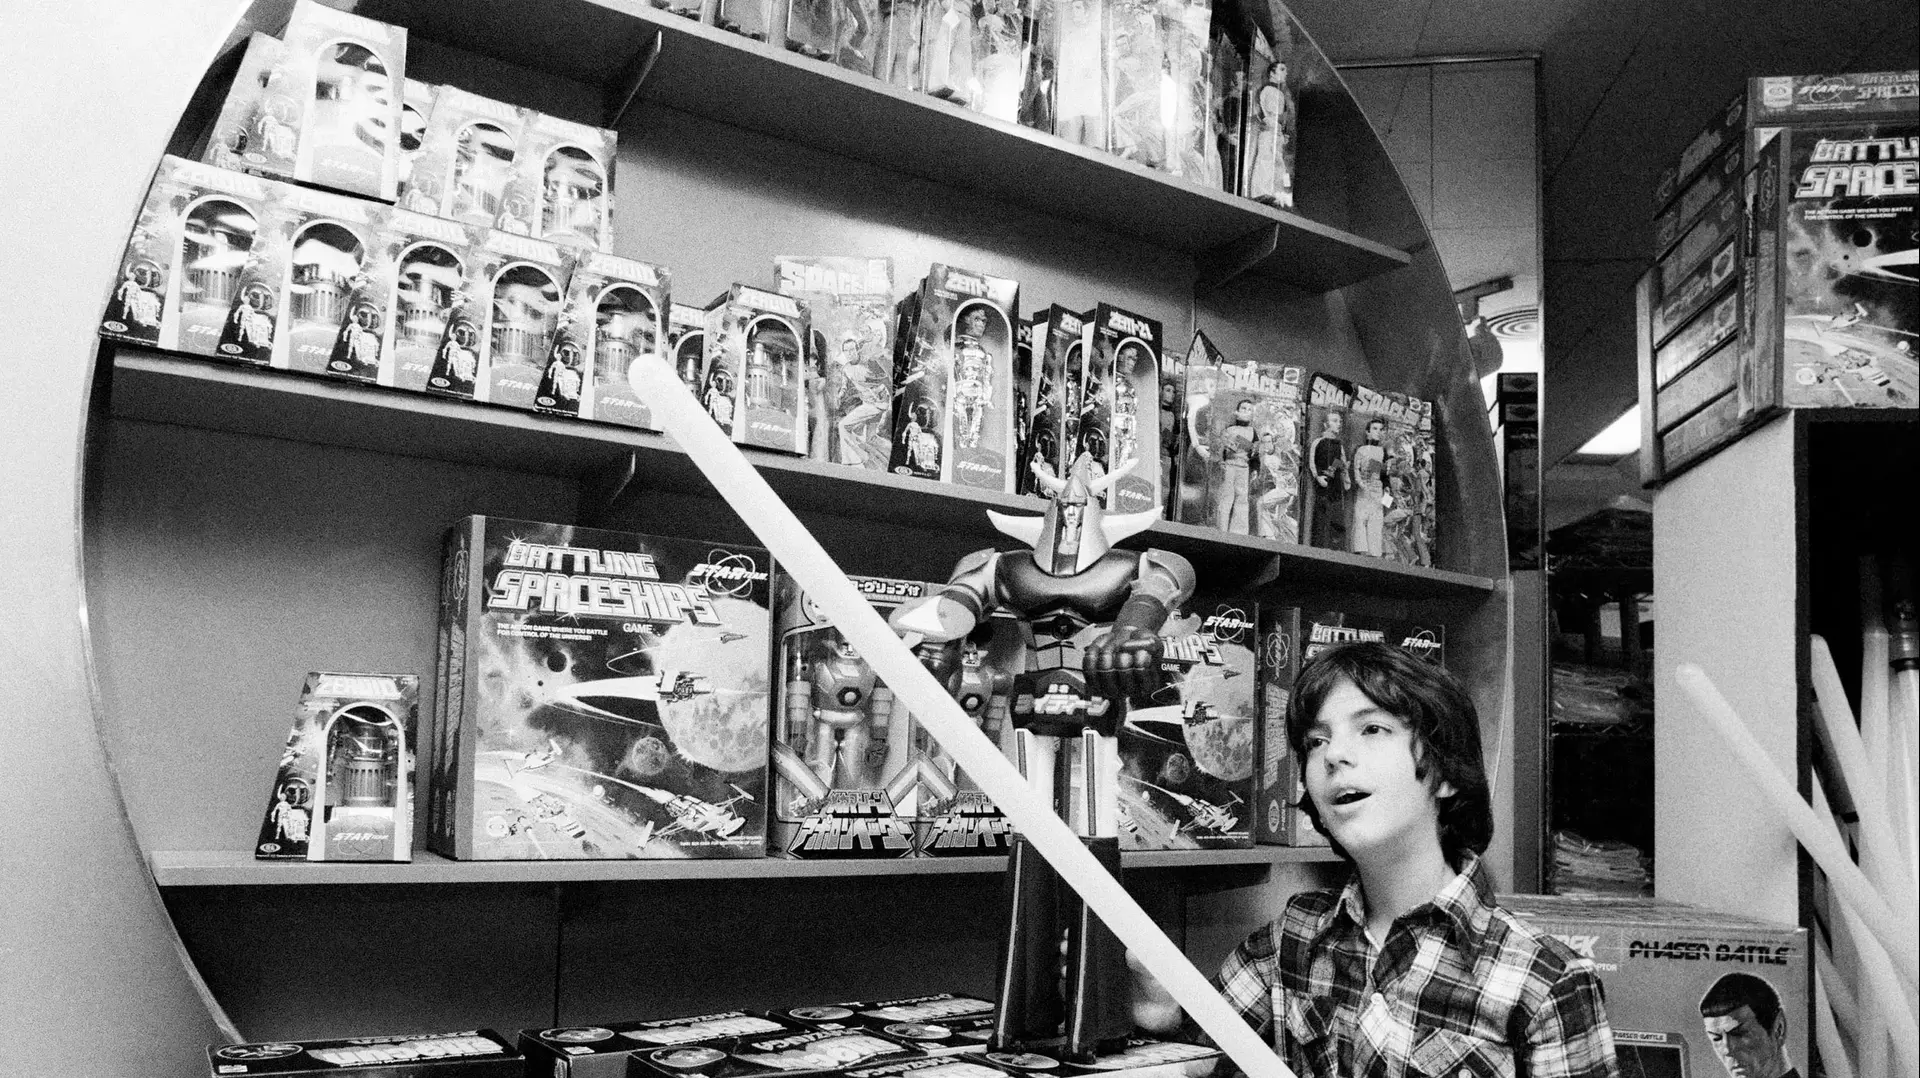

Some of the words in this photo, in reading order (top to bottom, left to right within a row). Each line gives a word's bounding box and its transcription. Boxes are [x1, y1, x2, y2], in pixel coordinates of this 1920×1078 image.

[1794, 161, 1919, 199] SPACE
[503, 542, 660, 580] BATTLING
[688, 563, 745, 580] STAR
[487, 569, 722, 628] SPACESHIPS
[497, 622, 510, 630] THE
[511, 623, 532, 631] ACTION
[533, 624, 551, 632] GAME
[551, 625, 572, 633] WHERE
[573, 626, 586, 634] YOU
[586, 627, 608, 636] BATTLE
[623, 622, 653, 634] GAME
[1204, 616, 1240, 628] STAR
[1401, 637, 1429, 648] STAR
[1161, 663, 1181, 672] GAME
[1629, 940, 1710, 961] PHASER
[1716, 943, 1790, 965] BATTLE
[1596, 963, 1617, 972] PTOR
